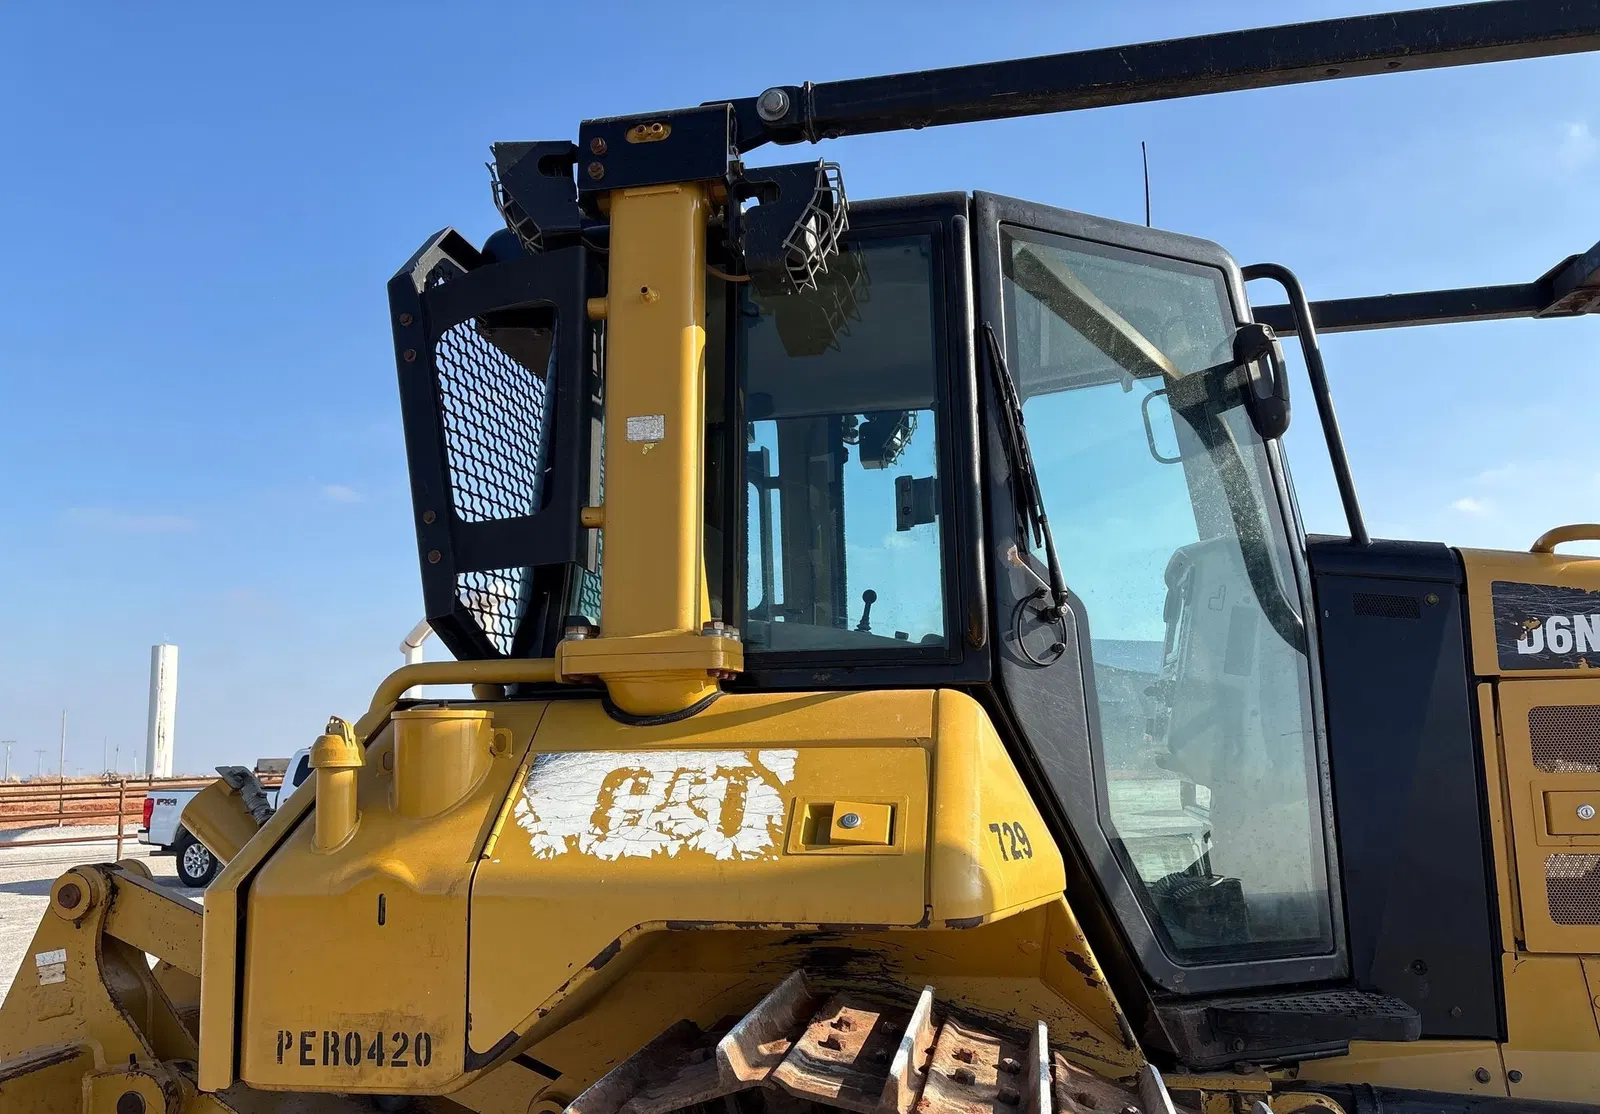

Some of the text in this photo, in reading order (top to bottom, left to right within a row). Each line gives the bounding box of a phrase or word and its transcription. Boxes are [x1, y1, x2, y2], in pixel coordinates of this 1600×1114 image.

[1517, 614, 1600, 654] D6N
[156, 798, 178, 807] FX4
[989, 821, 1032, 861] 729
